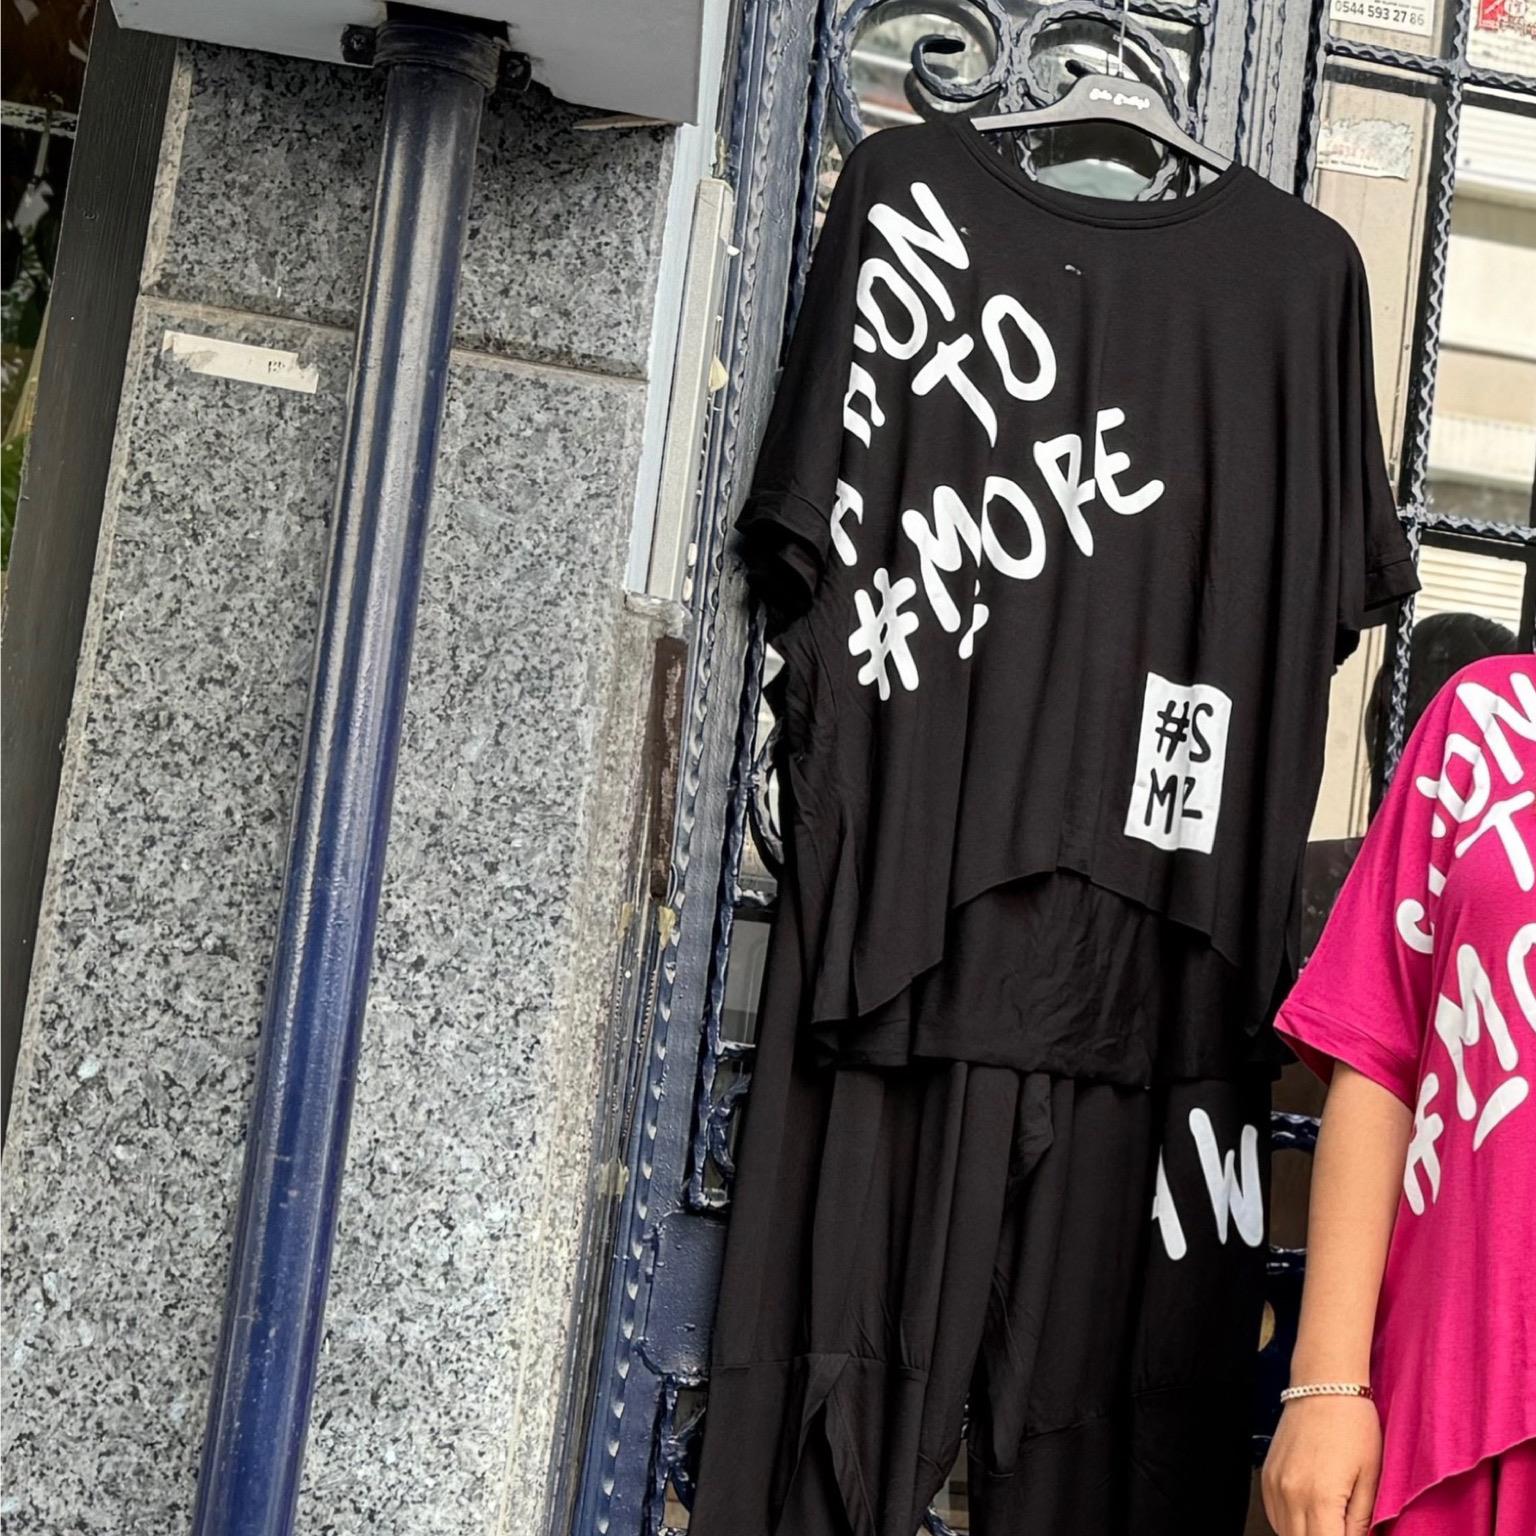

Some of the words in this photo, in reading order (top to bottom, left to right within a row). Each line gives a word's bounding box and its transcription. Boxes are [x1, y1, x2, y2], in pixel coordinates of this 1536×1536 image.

[1367, 5, 1389, 20] 593
[1393, 9, 1407, 23] 27
[911, 293, 1057, 449] TO
[1155, 700, 1214, 763] #S
